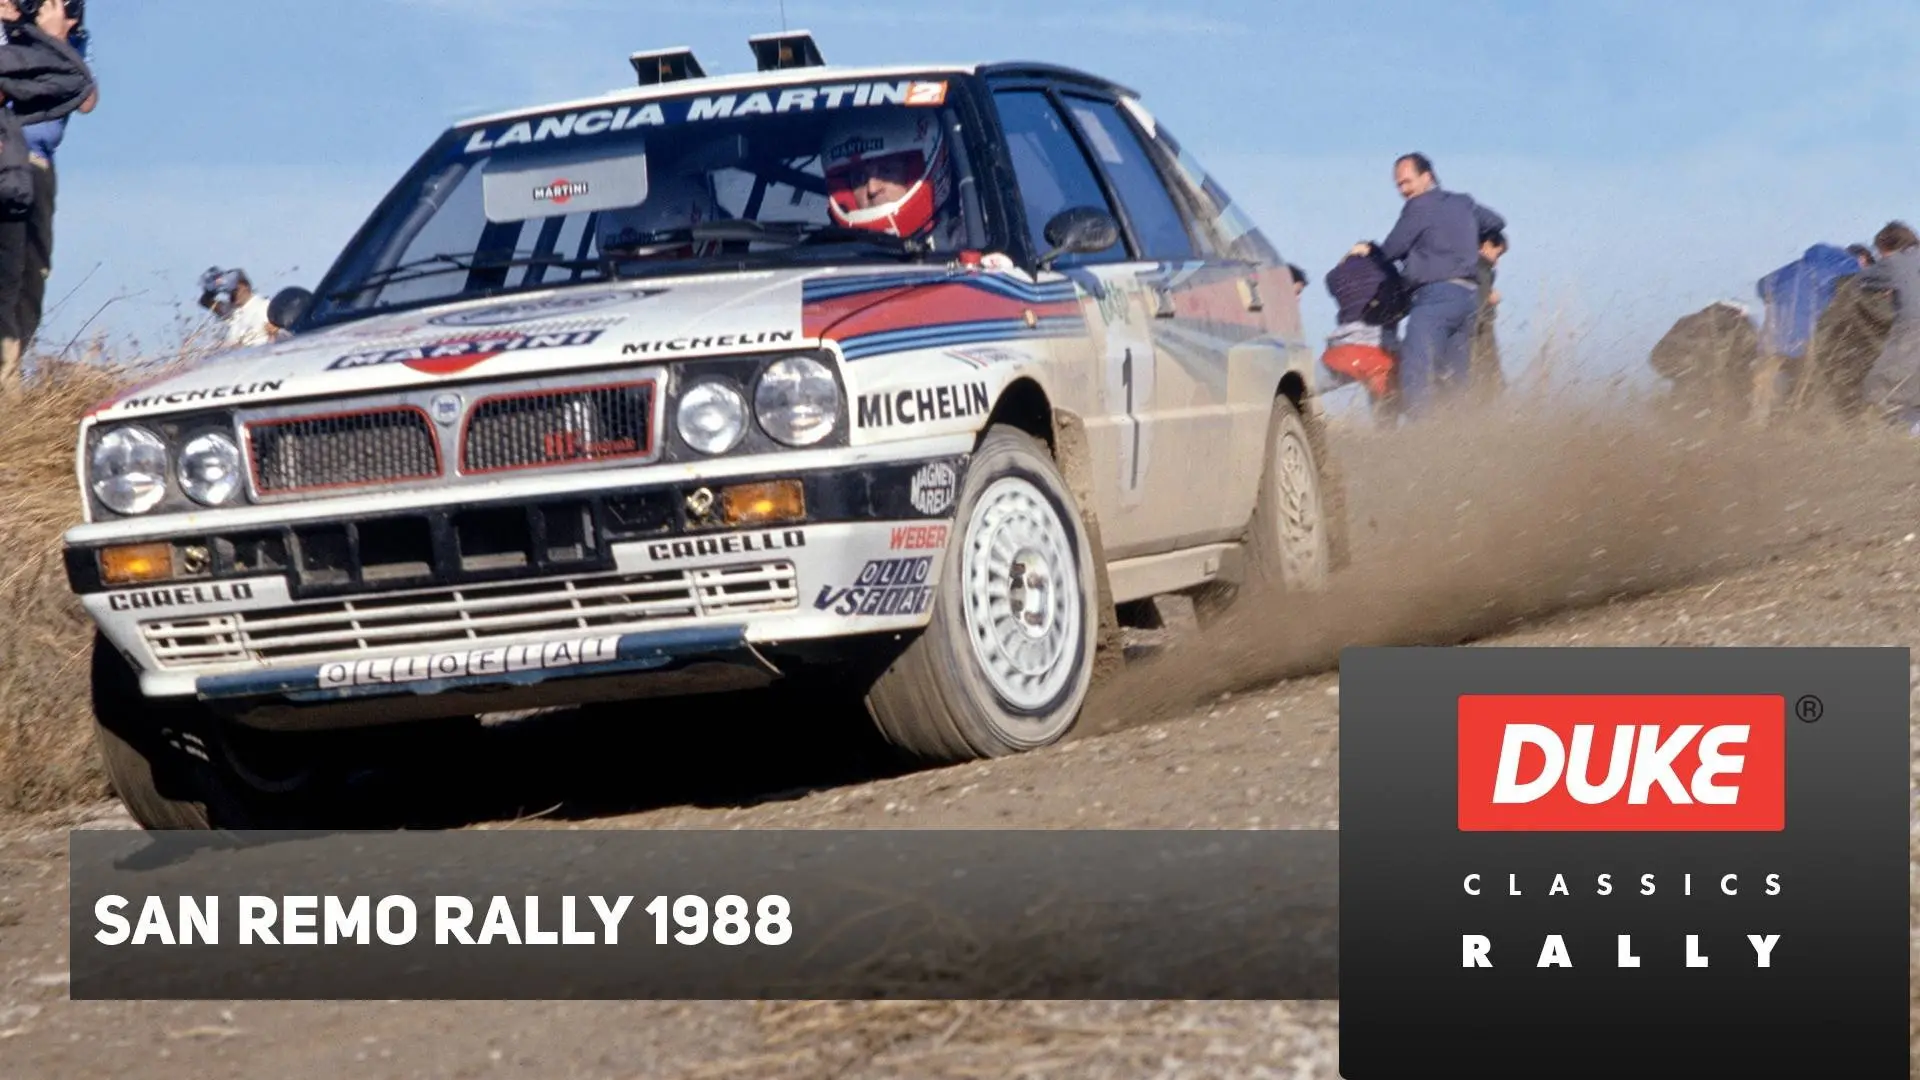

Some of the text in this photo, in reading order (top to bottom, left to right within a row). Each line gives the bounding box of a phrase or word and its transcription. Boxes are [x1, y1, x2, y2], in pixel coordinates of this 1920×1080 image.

[464, 103, 665, 154] LANCIA
[534, 183, 588, 200] MARTINI
[336, 330, 594, 366] MARTINI
[622, 330, 794, 354] MICHELIN
[124, 379, 284, 410] MICHELIN
[857, 381, 990, 428] MICHELIN
[1122, 348, 1140, 490] 1
[648, 529, 806, 561] CARELLO
[890, 525, 947, 549] WEBER
[862, 559, 928, 584] OLIO
[109, 583, 253, 611] CARELLO
